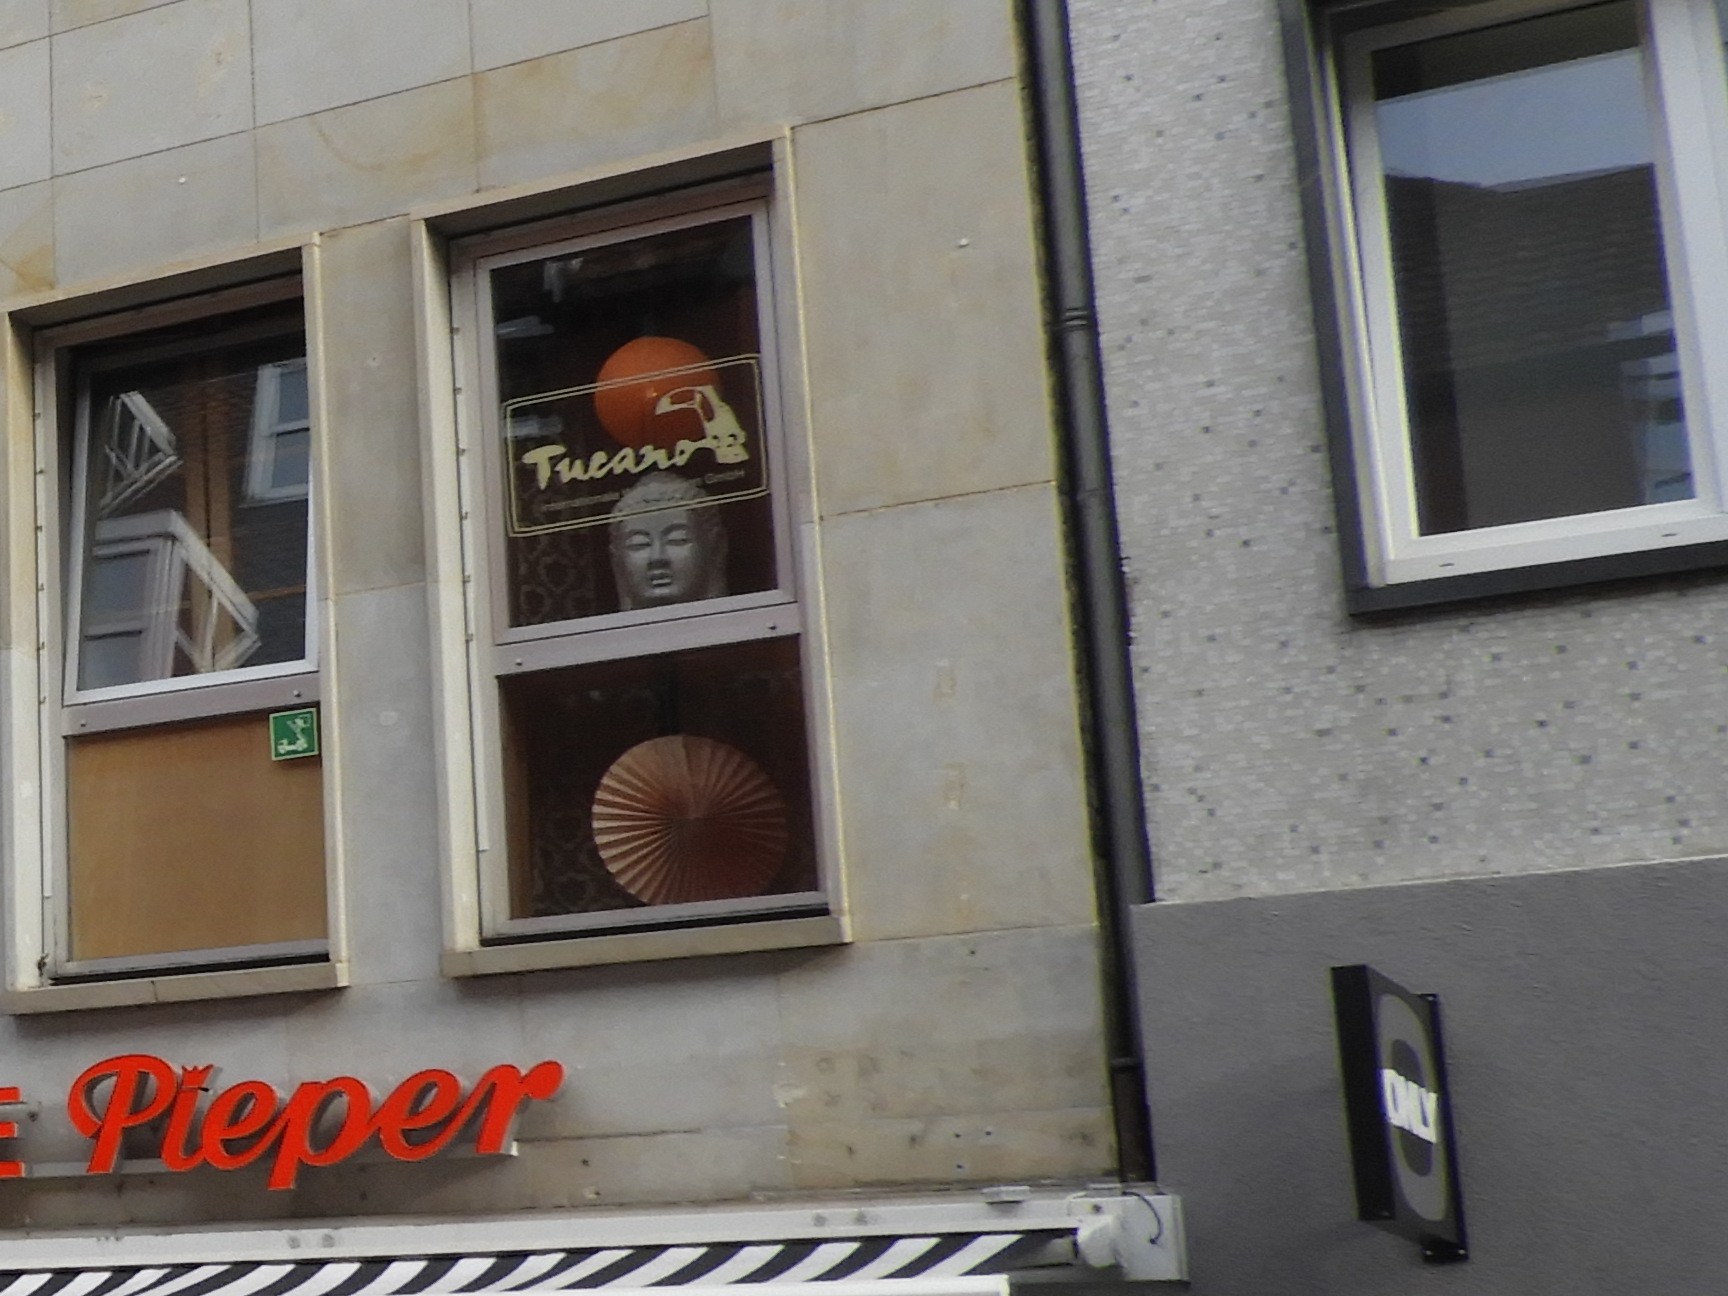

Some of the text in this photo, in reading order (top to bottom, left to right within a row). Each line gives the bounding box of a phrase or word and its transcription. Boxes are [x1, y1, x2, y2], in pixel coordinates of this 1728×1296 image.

[522, 440, 696, 491] Tucano
[66, 1052, 565, 1191] Pieper
[1380, 1067, 1439, 1144] ONLY
